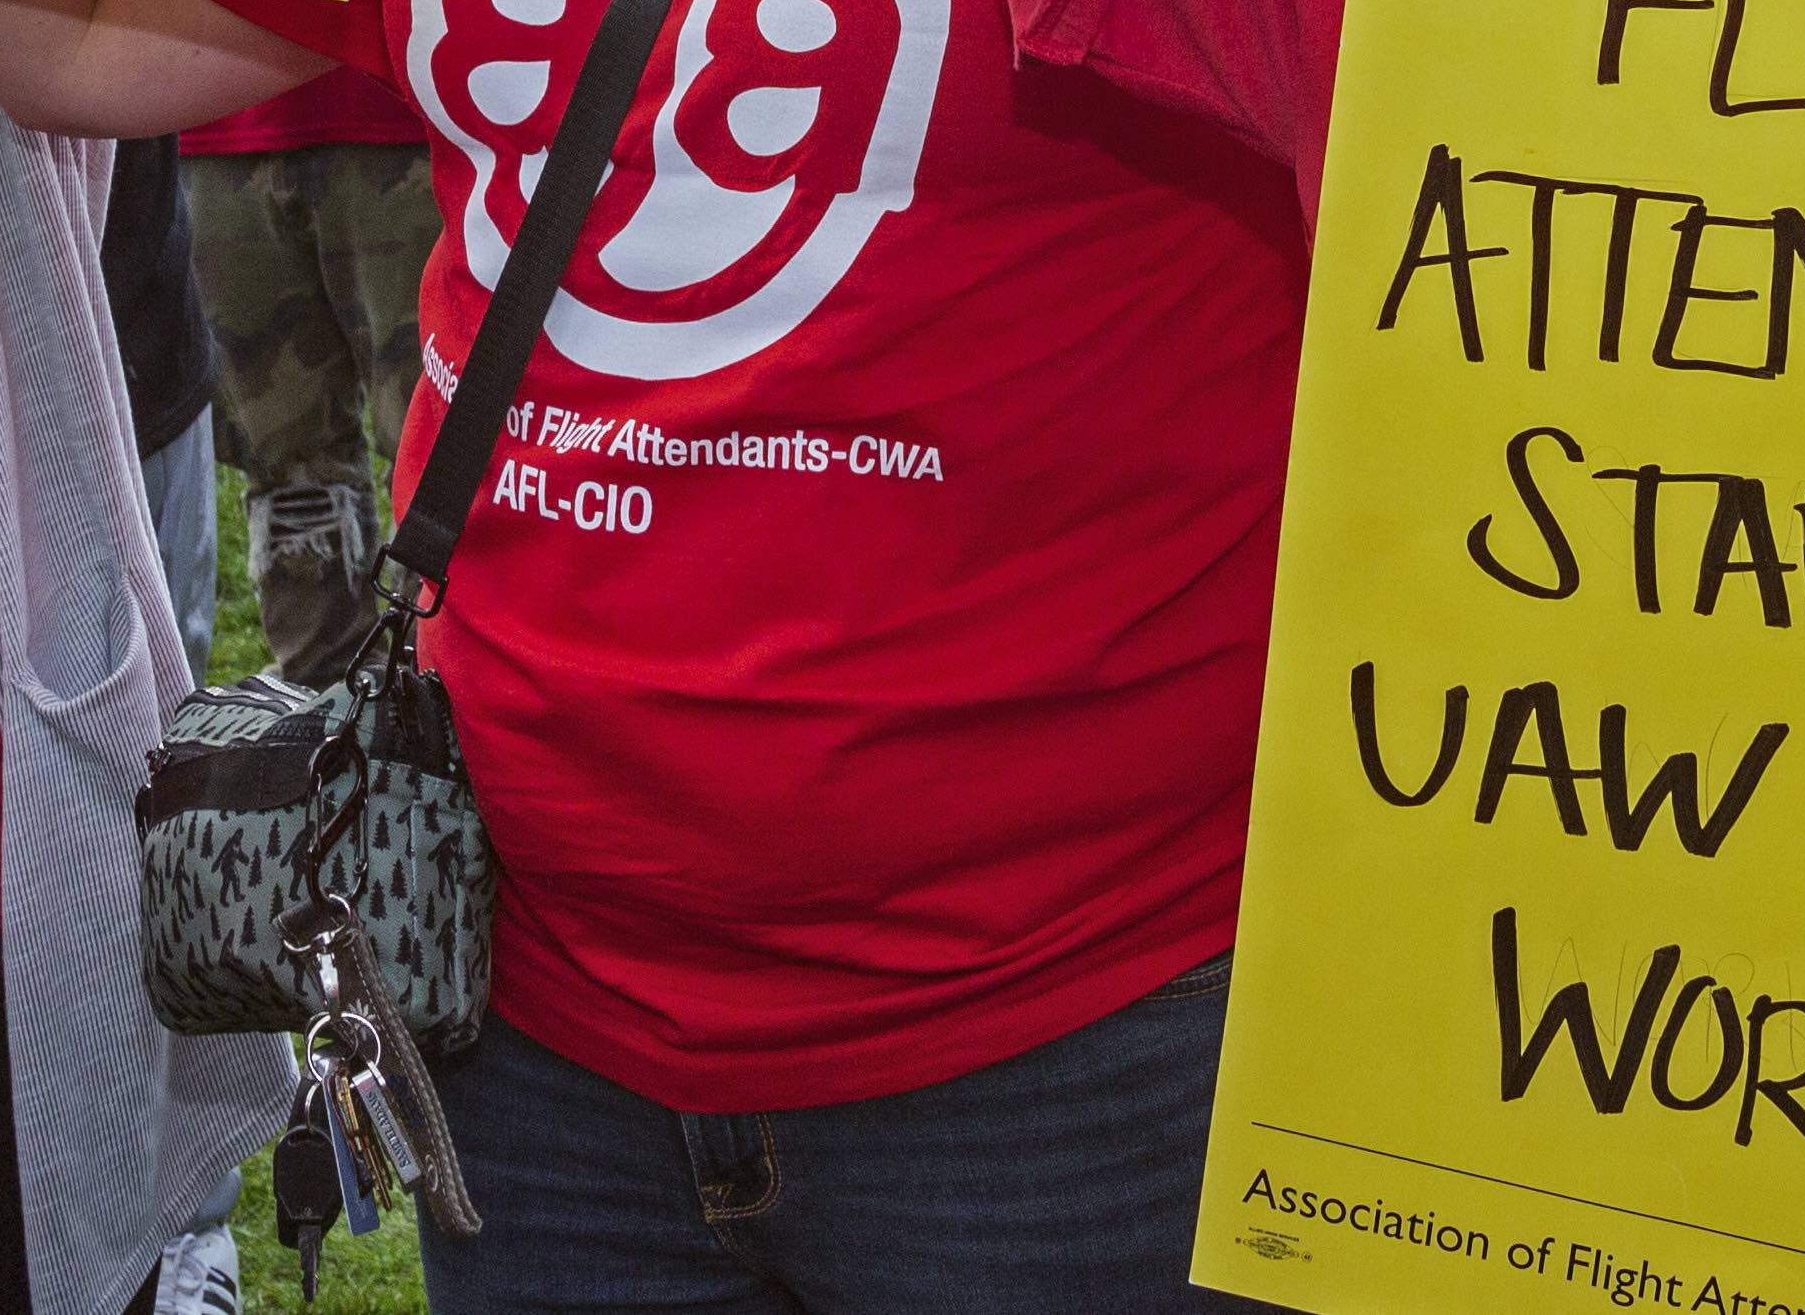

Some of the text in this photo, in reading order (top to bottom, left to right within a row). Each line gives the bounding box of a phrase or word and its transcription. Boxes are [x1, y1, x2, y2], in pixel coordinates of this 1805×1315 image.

[492, 458, 654, 534] AFL-CIO
[506, 401, 535, 442] of
[536, 405, 616, 455] Flight
[607, 418, 944, 482] Attendants-CWA
[1351, 661, 1790, 858] UAW
[1242, 1168, 1489, 1260] Association
[1507, 1237, 1556, 1274] of
[1566, 1243, 1683, 1308] Flight
